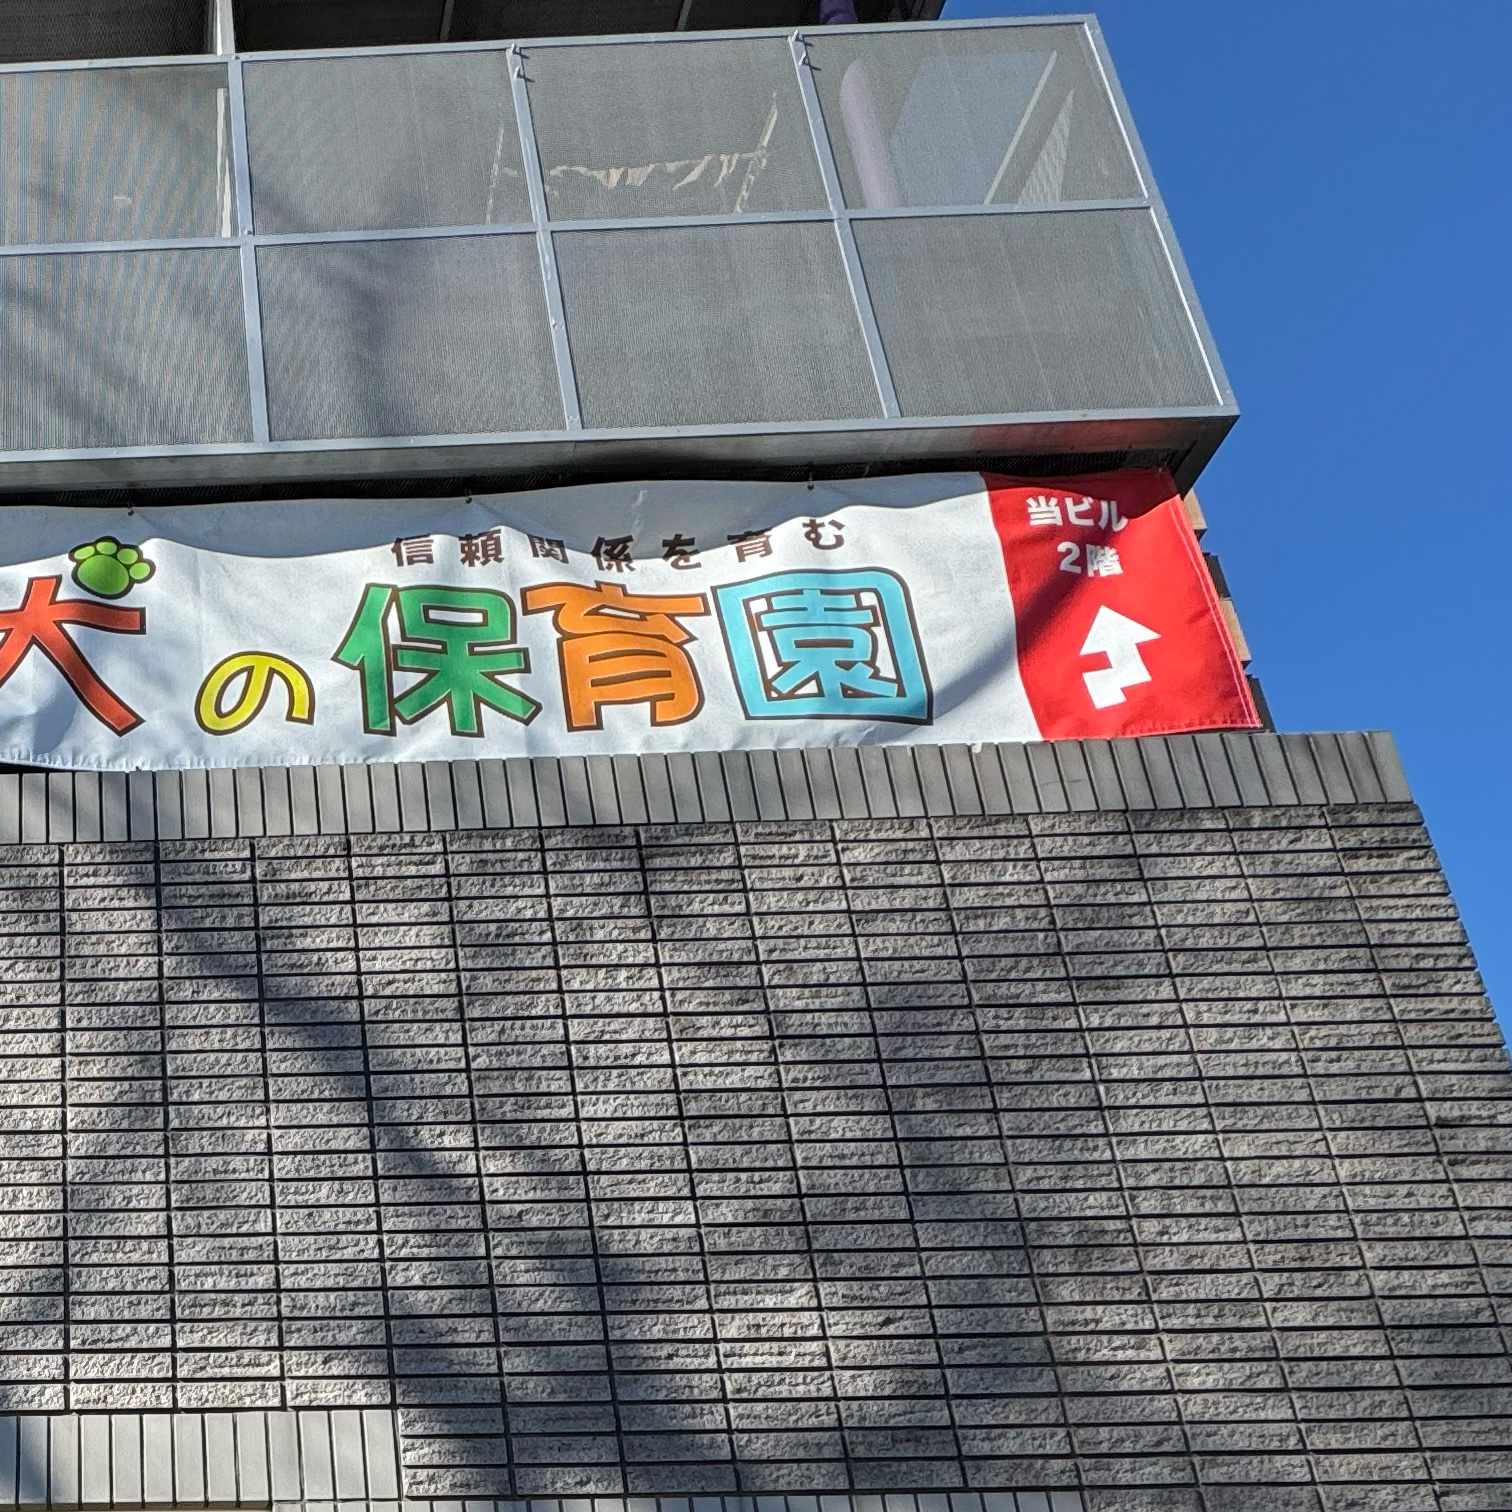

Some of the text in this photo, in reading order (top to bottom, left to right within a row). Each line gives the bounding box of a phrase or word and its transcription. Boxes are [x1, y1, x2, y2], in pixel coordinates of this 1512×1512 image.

[1026, 495, 1128, 532] 当ビル
[391, 517, 846, 573] 信頼関係を育む
[1056, 541, 1123, 577] 2階
